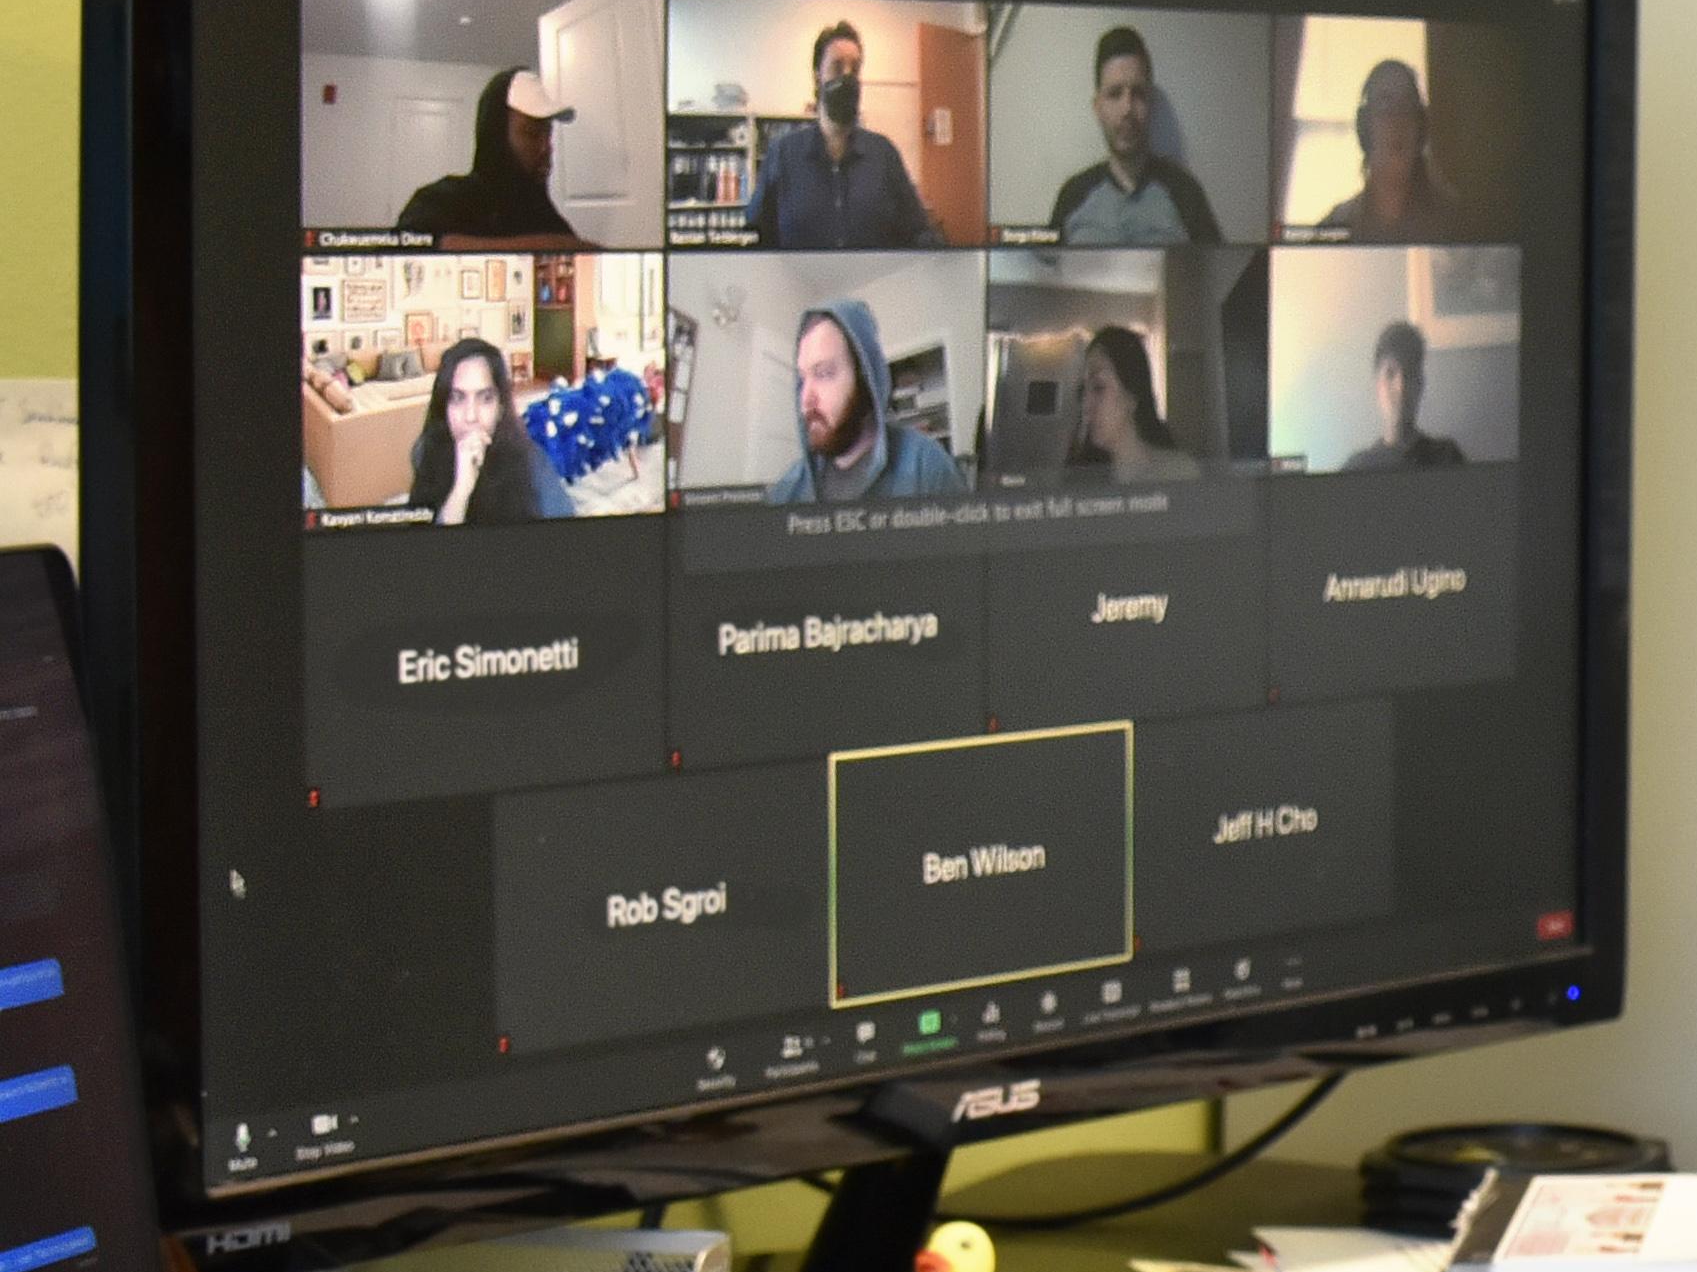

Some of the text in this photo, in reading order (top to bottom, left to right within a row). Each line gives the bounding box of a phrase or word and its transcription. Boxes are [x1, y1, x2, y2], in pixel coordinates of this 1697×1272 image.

[1090, 592, 1169, 624] Jeremy
[718, 611, 938, 655] Parima Bajracharya
[398, 637, 579, 684] Eric Simonetti
[1213, 806, 1319, 846] Jeff H Cho
[922, 844, 1046, 884] Ben Wilson
[607, 881, 727, 927] Rob Sgroi
[951, 1078, 1041, 1123] ASUS
[206, 1221, 292, 1255] HDMI
